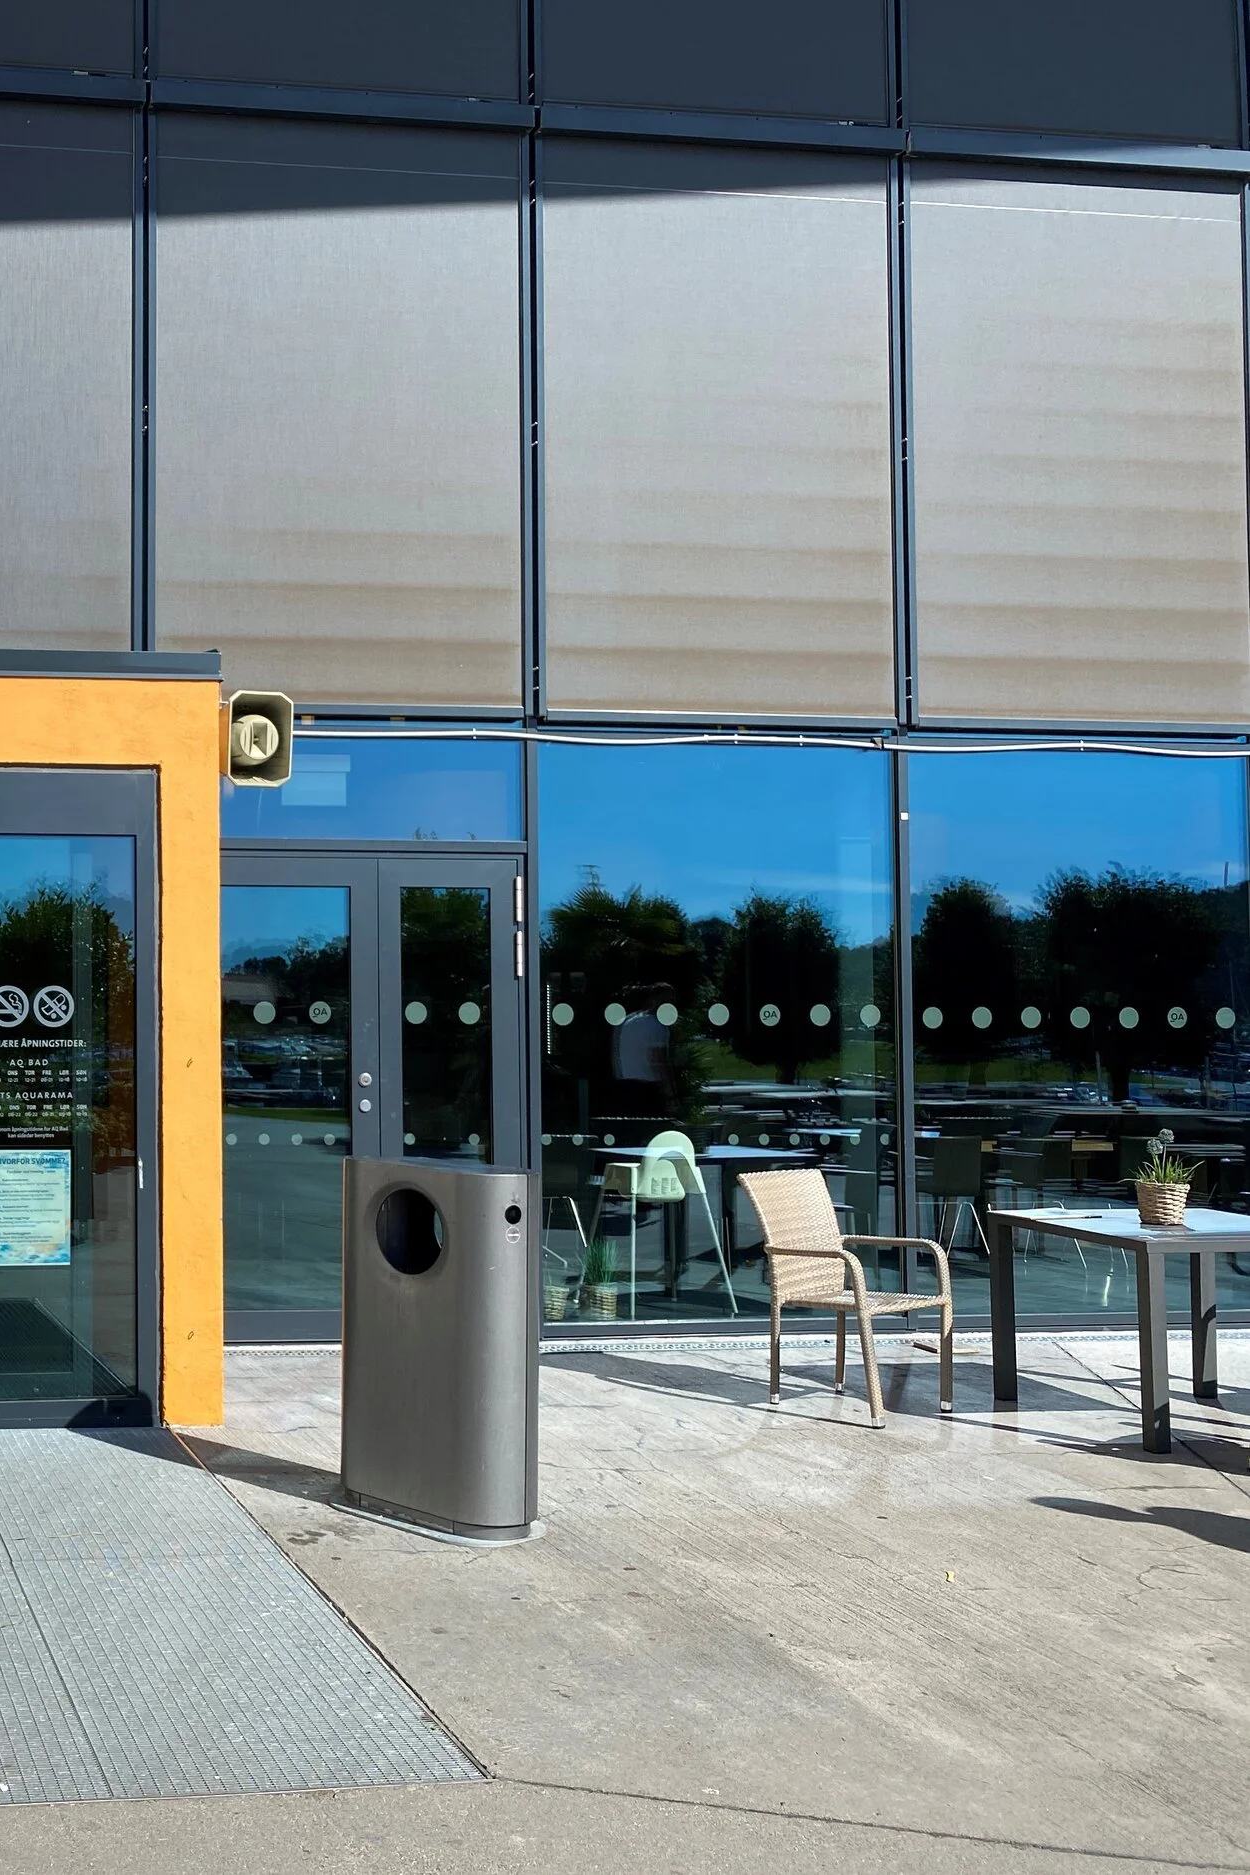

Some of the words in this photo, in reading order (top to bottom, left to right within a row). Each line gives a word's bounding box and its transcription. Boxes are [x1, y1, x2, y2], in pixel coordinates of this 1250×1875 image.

[21, 1038, 87, 1048] ÅPNINGSTIDER:
[10, 1059, 24, 1068] AQ
[15, 1092, 73, 1100] AQUARAMA
